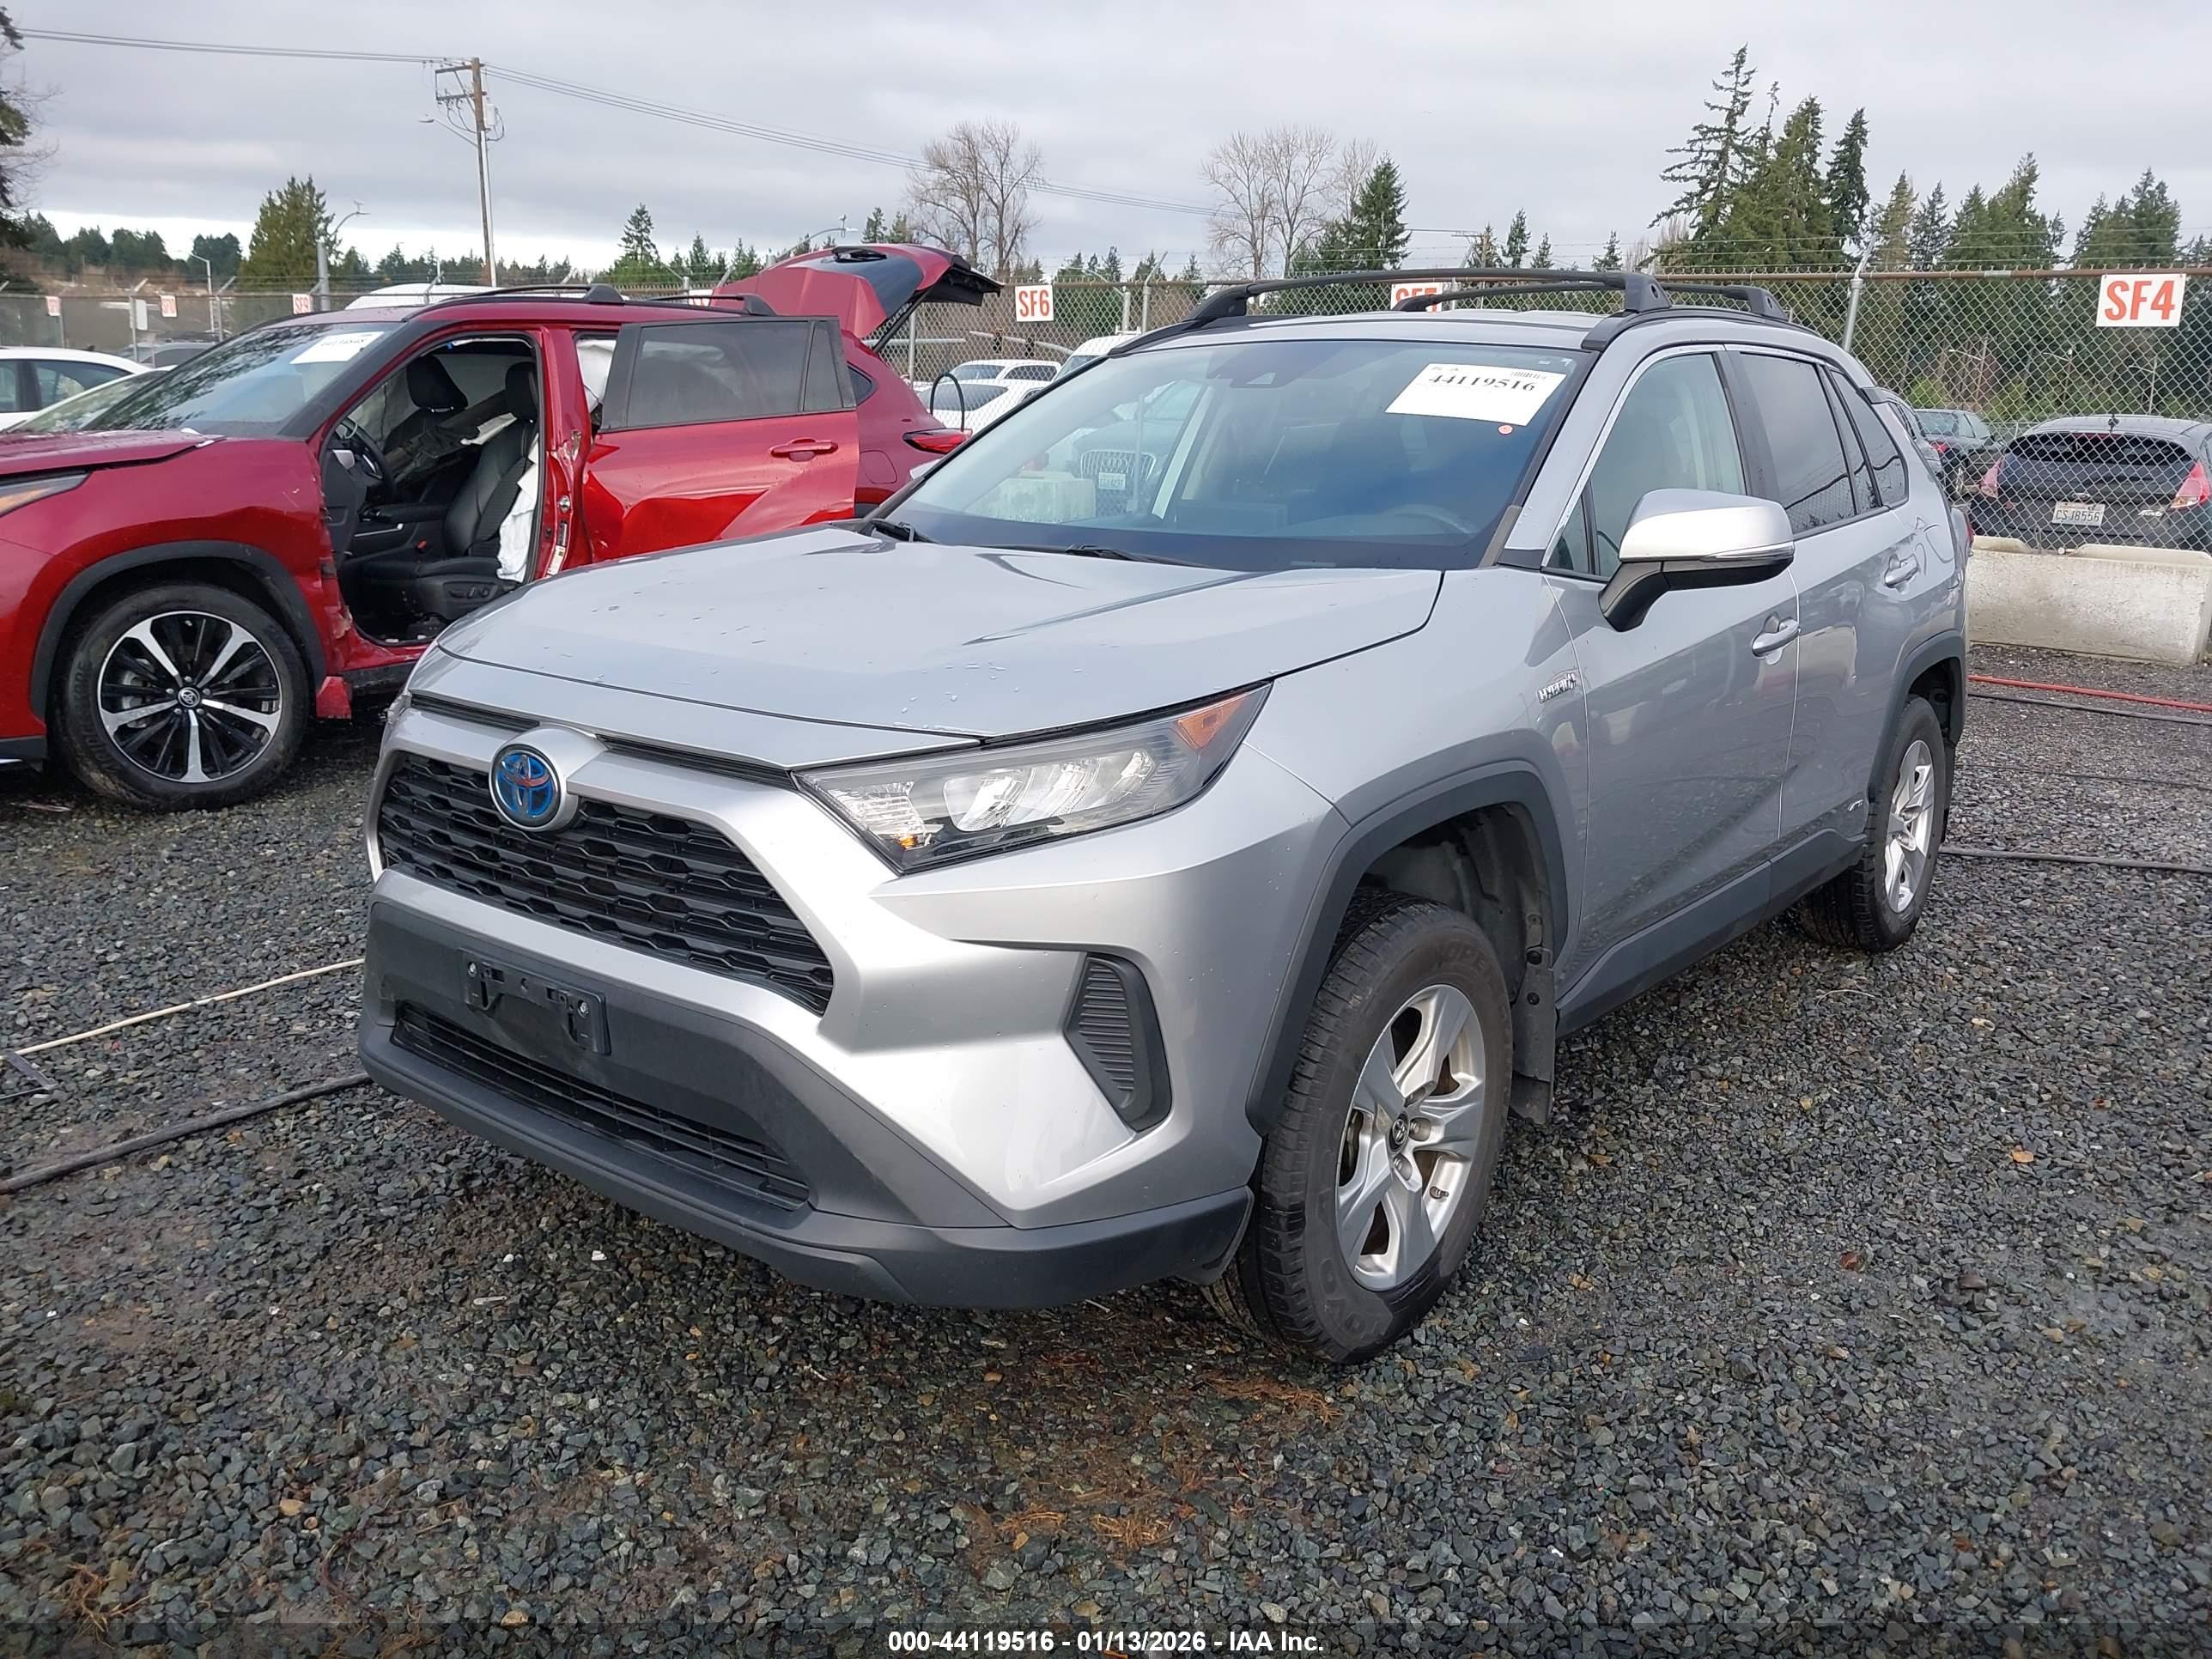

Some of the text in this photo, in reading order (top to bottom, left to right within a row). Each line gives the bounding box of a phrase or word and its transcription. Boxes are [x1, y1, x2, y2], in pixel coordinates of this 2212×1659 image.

[1018, 289, 1049, 317] SF6
[2105, 280, 2175, 320] SF4
[1429, 374, 1535, 392] 44119516
